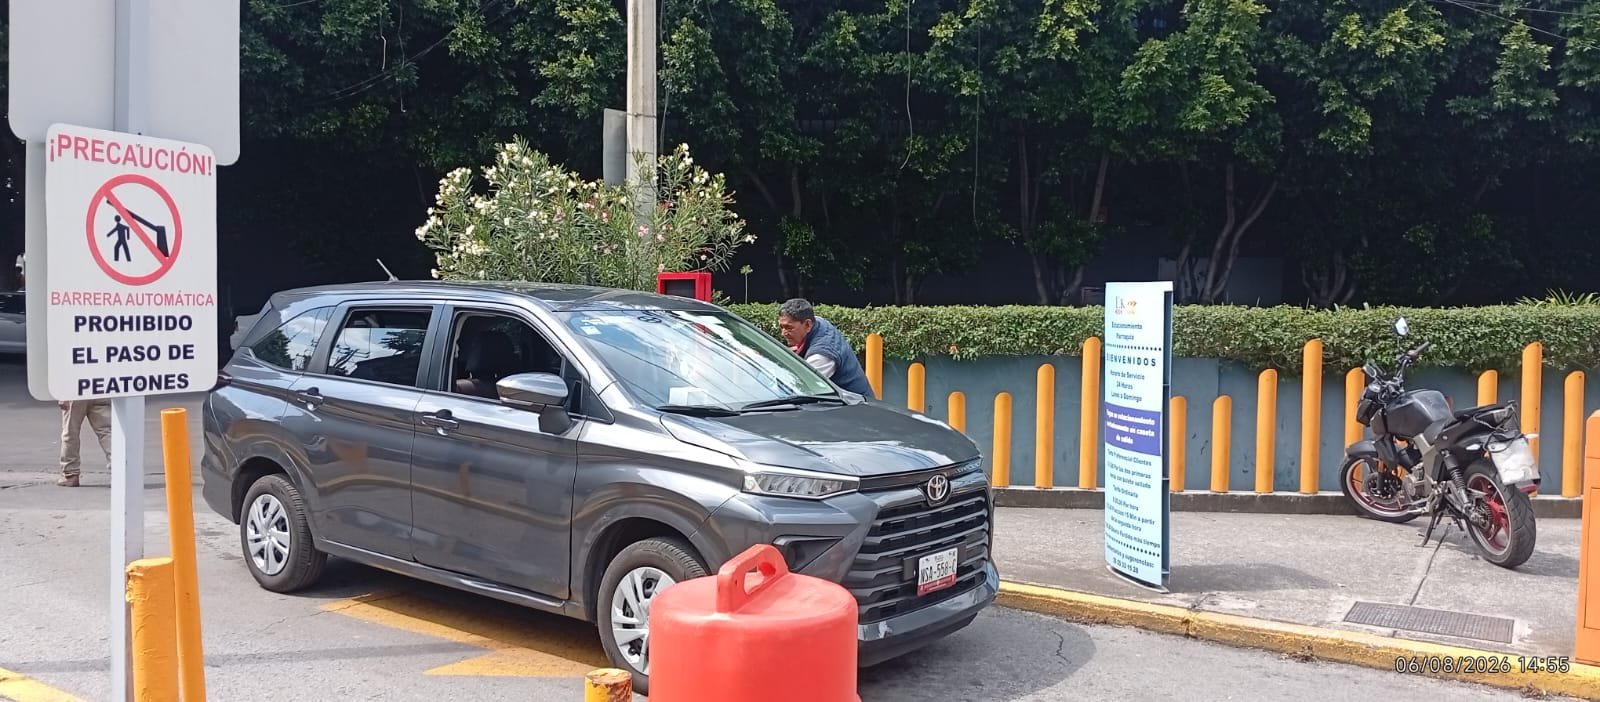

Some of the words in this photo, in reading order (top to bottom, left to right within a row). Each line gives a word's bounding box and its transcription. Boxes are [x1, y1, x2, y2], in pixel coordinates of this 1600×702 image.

[50, 134, 213, 176] ¡PRECAUCIÓN!
[51, 291, 122, 307] BARRERA
[125, 290, 215, 307] AUTOMÁTICA
[74, 315, 193, 333] PROHIBIDO
[72, 347, 99, 364] EL
[106, 345, 161, 363] PASO
[168, 344, 195, 360] DE
[78, 373, 189, 396] PEATONES
[1133, 456, 1152, 467] Clientes
[1131, 469, 1151, 479] primeras
[1141, 516, 1155, 527] partir
